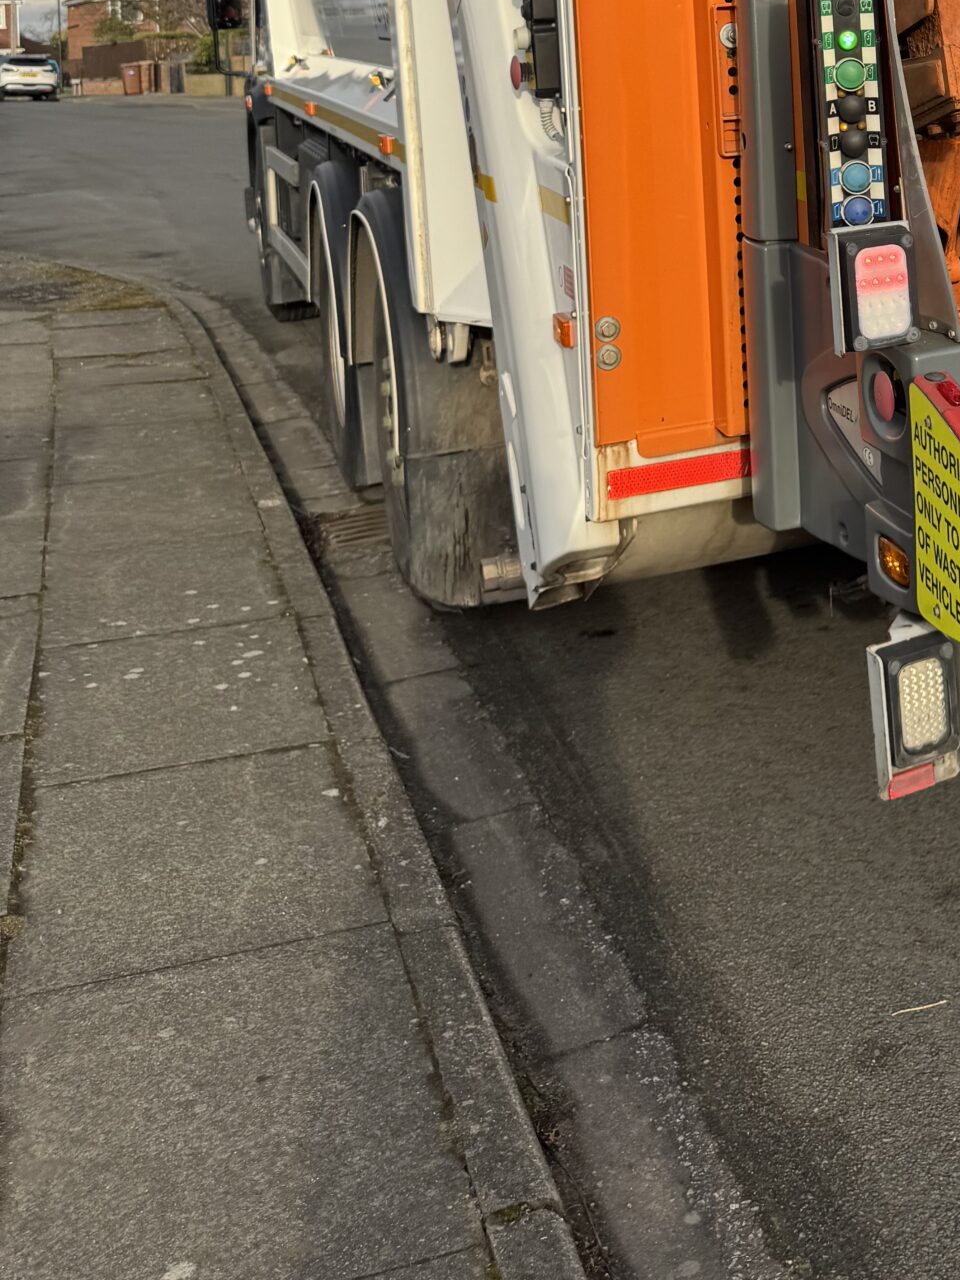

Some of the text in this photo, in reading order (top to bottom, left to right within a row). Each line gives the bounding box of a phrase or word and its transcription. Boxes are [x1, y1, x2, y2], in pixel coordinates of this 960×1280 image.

[829, 100, 877, 115] A B
[828, 396, 854, 423] OmniDEL
[916, 491, 942, 533] ONLY
[944, 517, 960, 551] TO
[917, 525, 931, 554] OF
